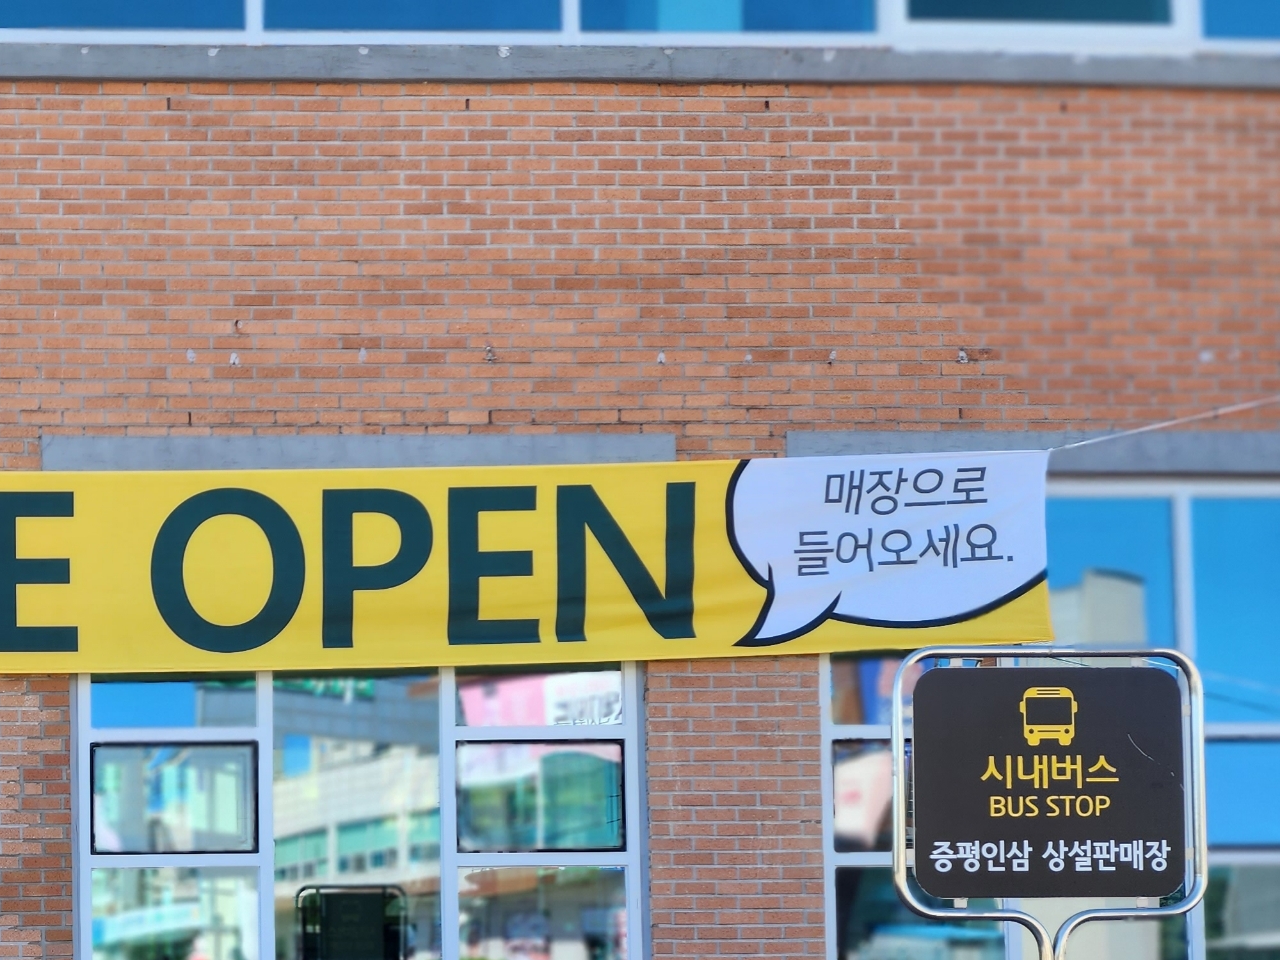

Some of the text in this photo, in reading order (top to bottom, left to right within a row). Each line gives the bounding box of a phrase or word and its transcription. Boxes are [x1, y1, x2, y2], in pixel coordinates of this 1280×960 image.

[824, 466, 989, 516] 매장으로
[149, 481, 696, 654] OPEN
[793, 523, 1015, 577] 들어오세요.
[980, 753, 1120, 790] 시내버스
[989, 795, 1111, 818] BUS STOP
[928, 839, 1171, 873] 증평인삼 상설판매장
